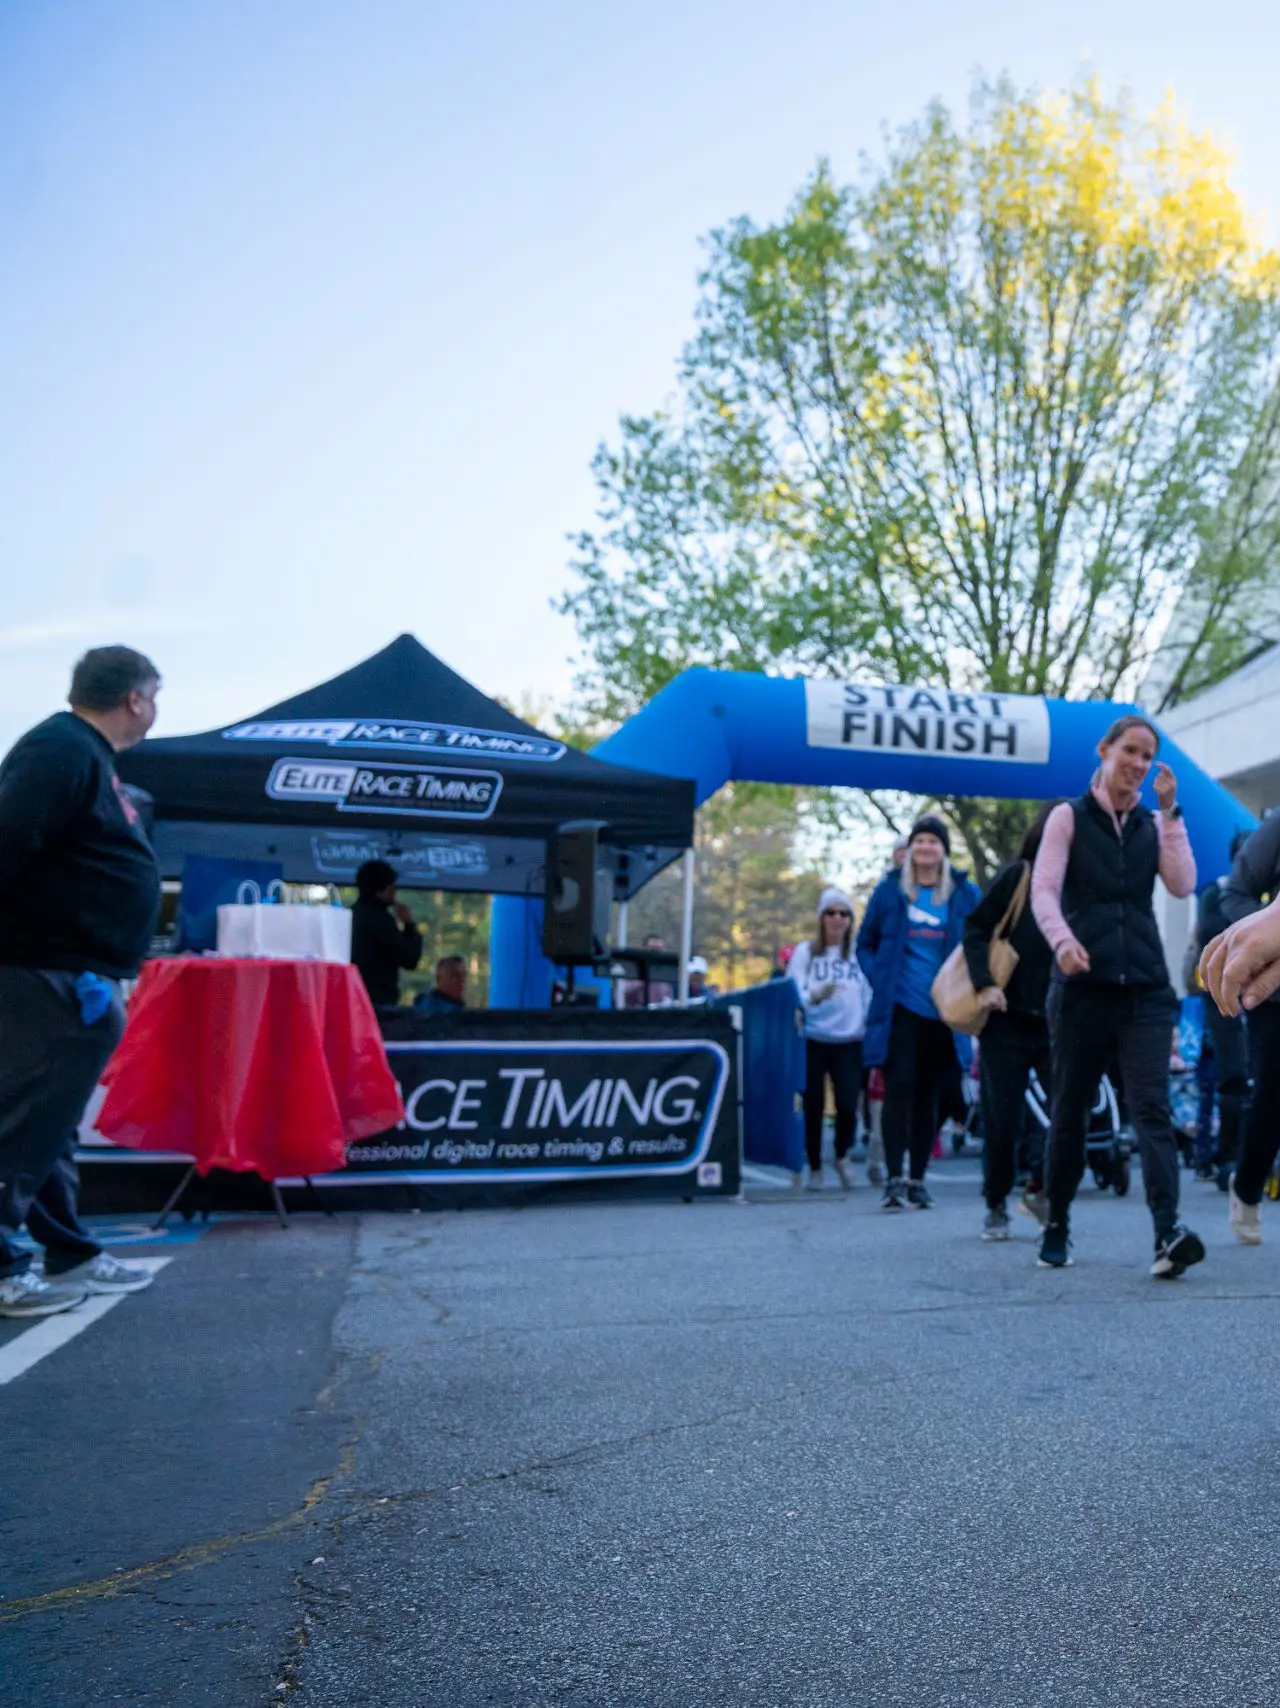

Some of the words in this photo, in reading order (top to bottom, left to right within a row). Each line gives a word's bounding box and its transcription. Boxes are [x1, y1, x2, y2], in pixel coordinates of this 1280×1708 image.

[843, 684, 1009, 717] START
[353, 723, 439, 744] RACE
[841, 711, 1018, 756] FINISH
[281, 767, 348, 791] ELITE
[352, 770, 414, 797] RACE
[416, 774, 492, 803] TIMING
[813, 958, 862, 984] USA
[397, 1078, 487, 1131] CE
[431, 1138, 496, 1165] digital
[496, 1142, 540, 1159] race
[543, 1137, 605, 1162] timing
[607, 1135, 625, 1156] &
[627, 1133, 688, 1155] results
